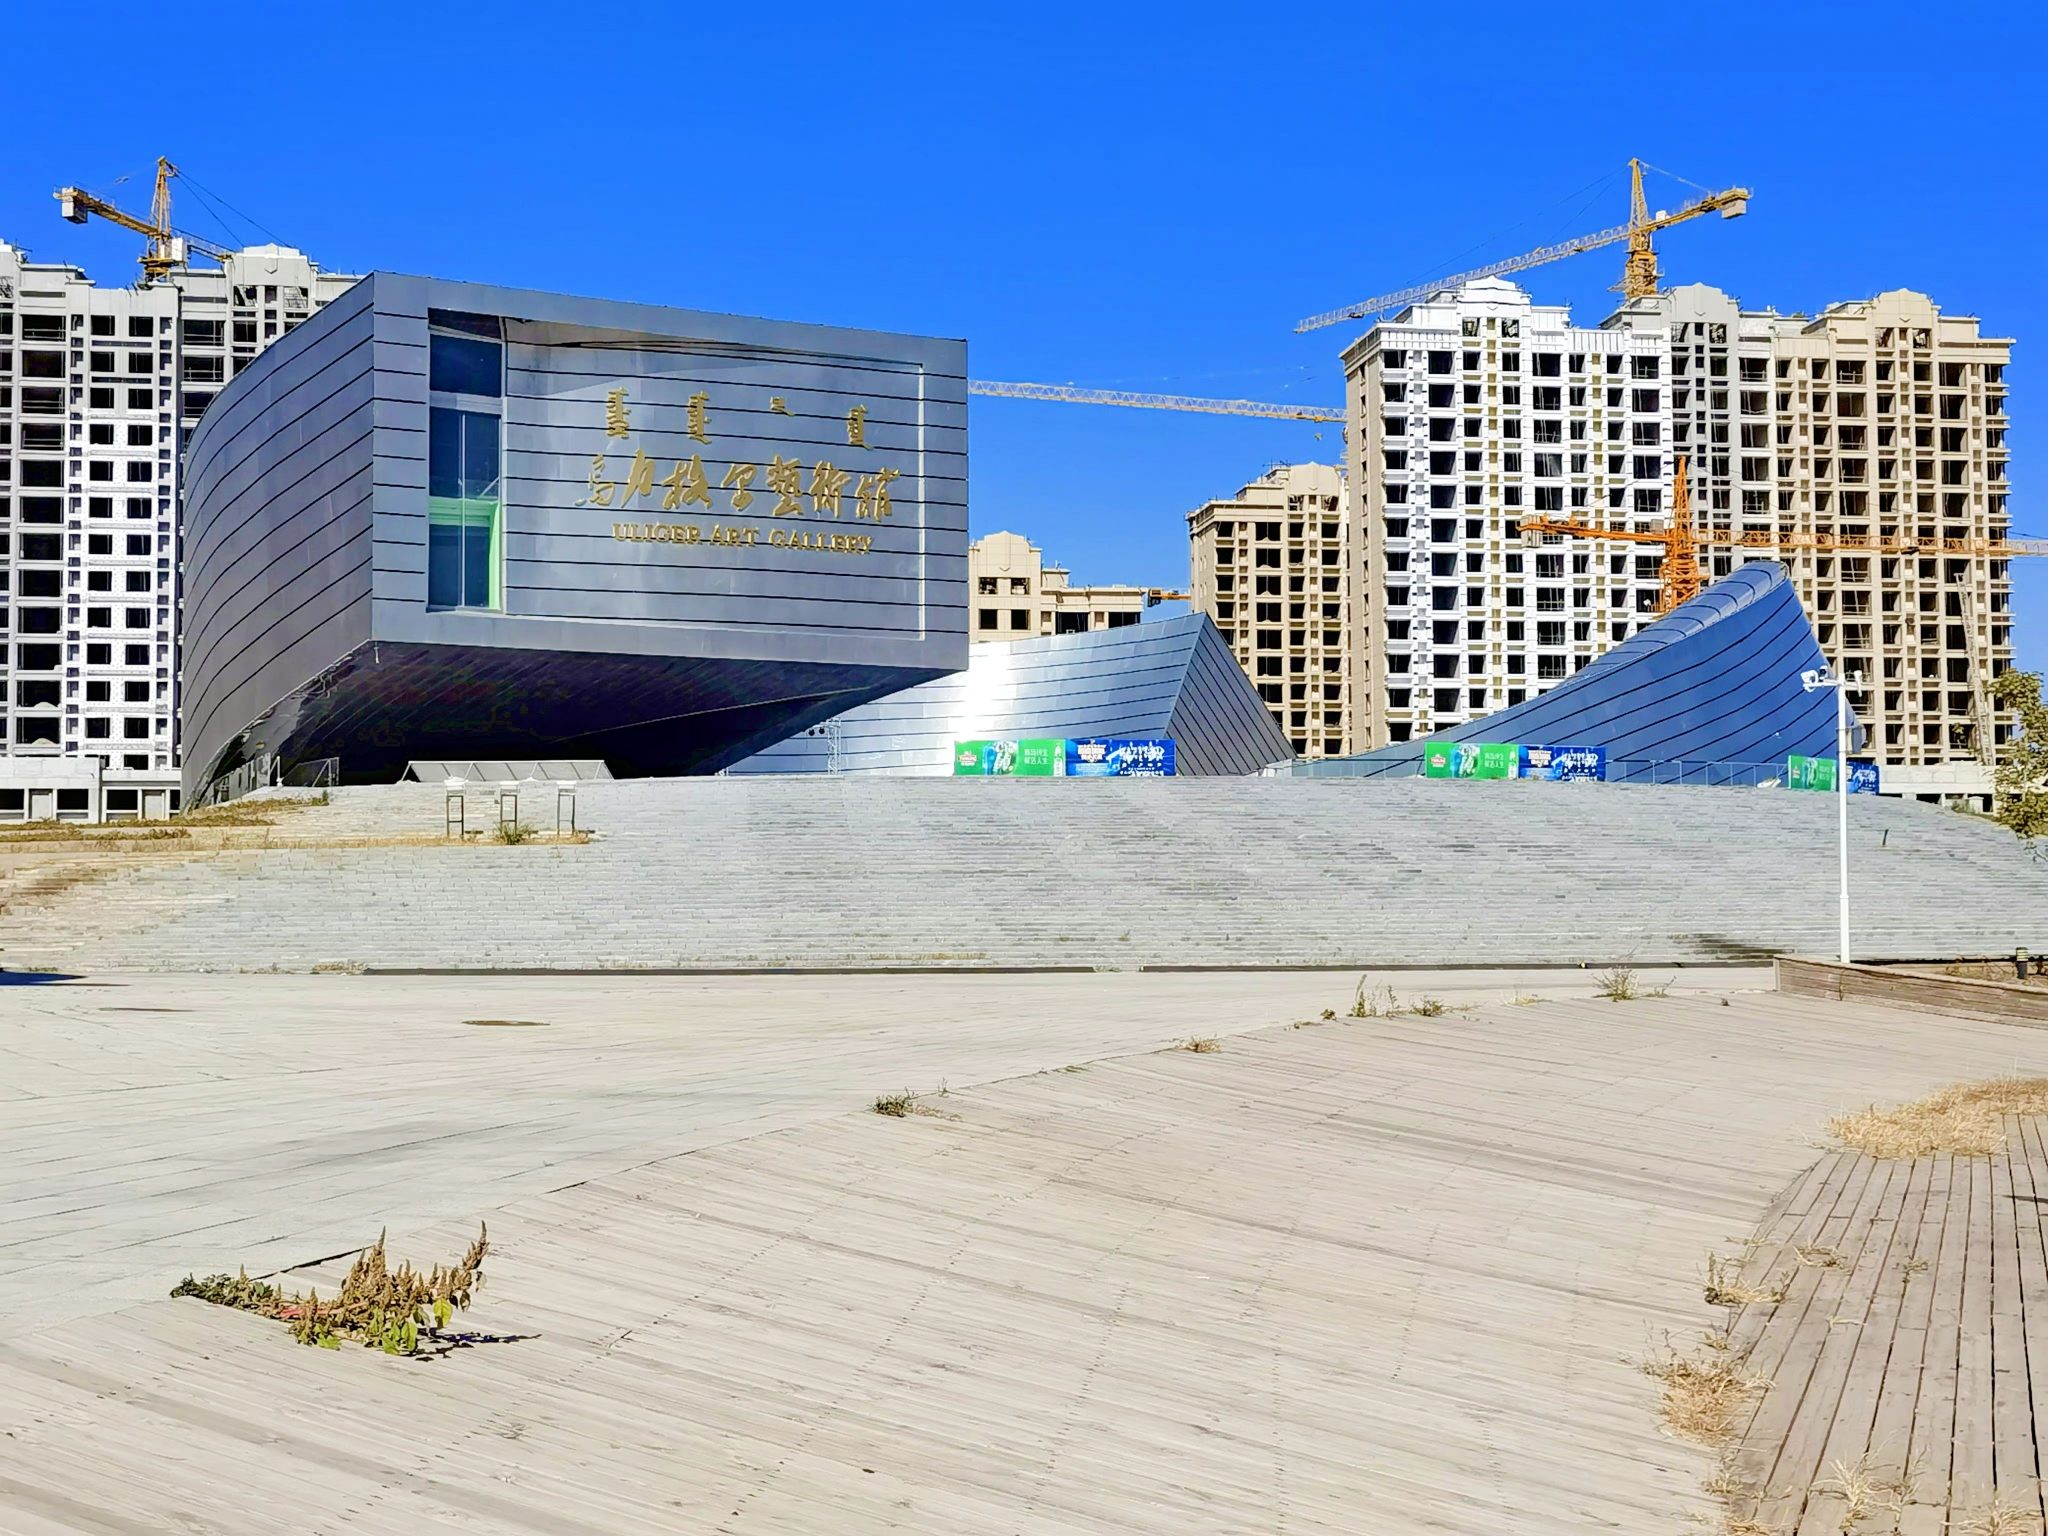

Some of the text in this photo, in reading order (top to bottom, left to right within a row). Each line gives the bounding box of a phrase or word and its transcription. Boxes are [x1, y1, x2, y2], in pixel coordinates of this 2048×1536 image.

[612, 522, 874, 554] ULIGER ART GALLERY
